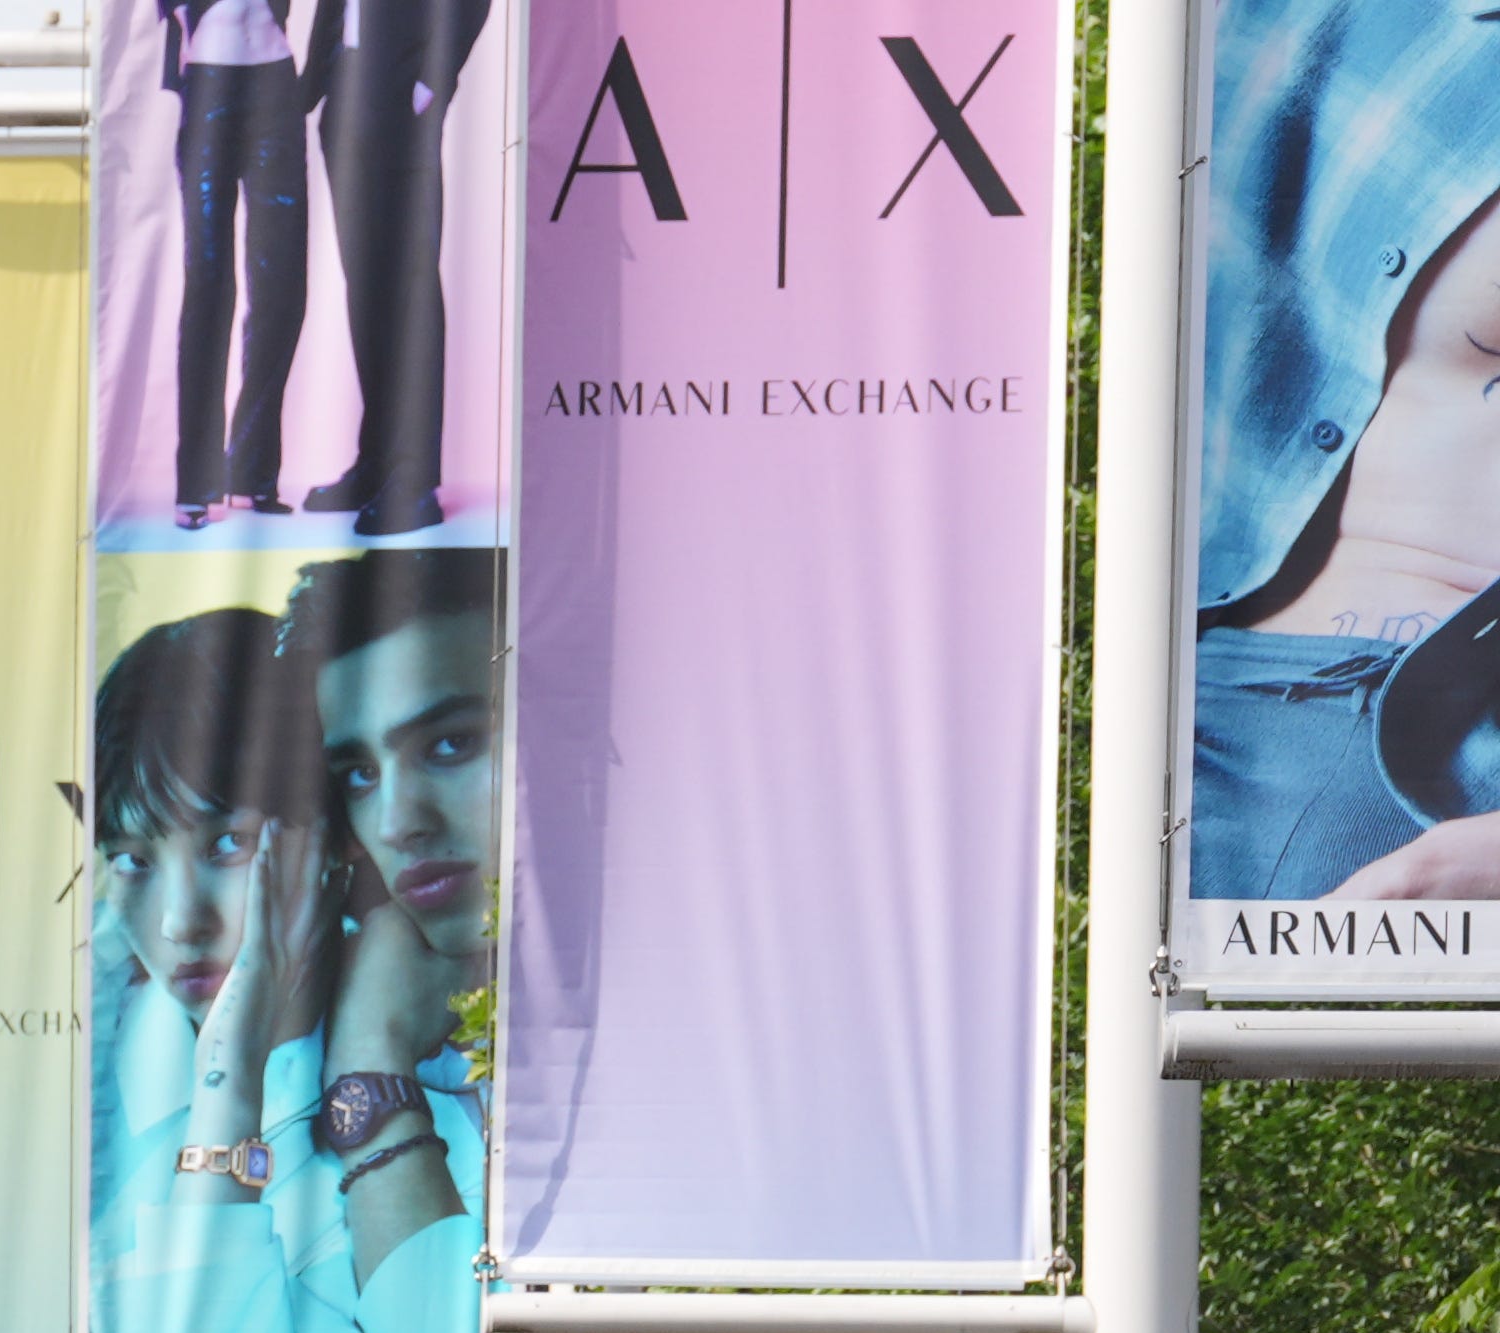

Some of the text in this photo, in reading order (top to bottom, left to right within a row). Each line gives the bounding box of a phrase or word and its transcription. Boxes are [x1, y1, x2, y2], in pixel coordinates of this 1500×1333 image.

[544, 375, 1024, 419] ARMANI EXCHANGE
[1221, 908, 1470, 956] ARMANI
